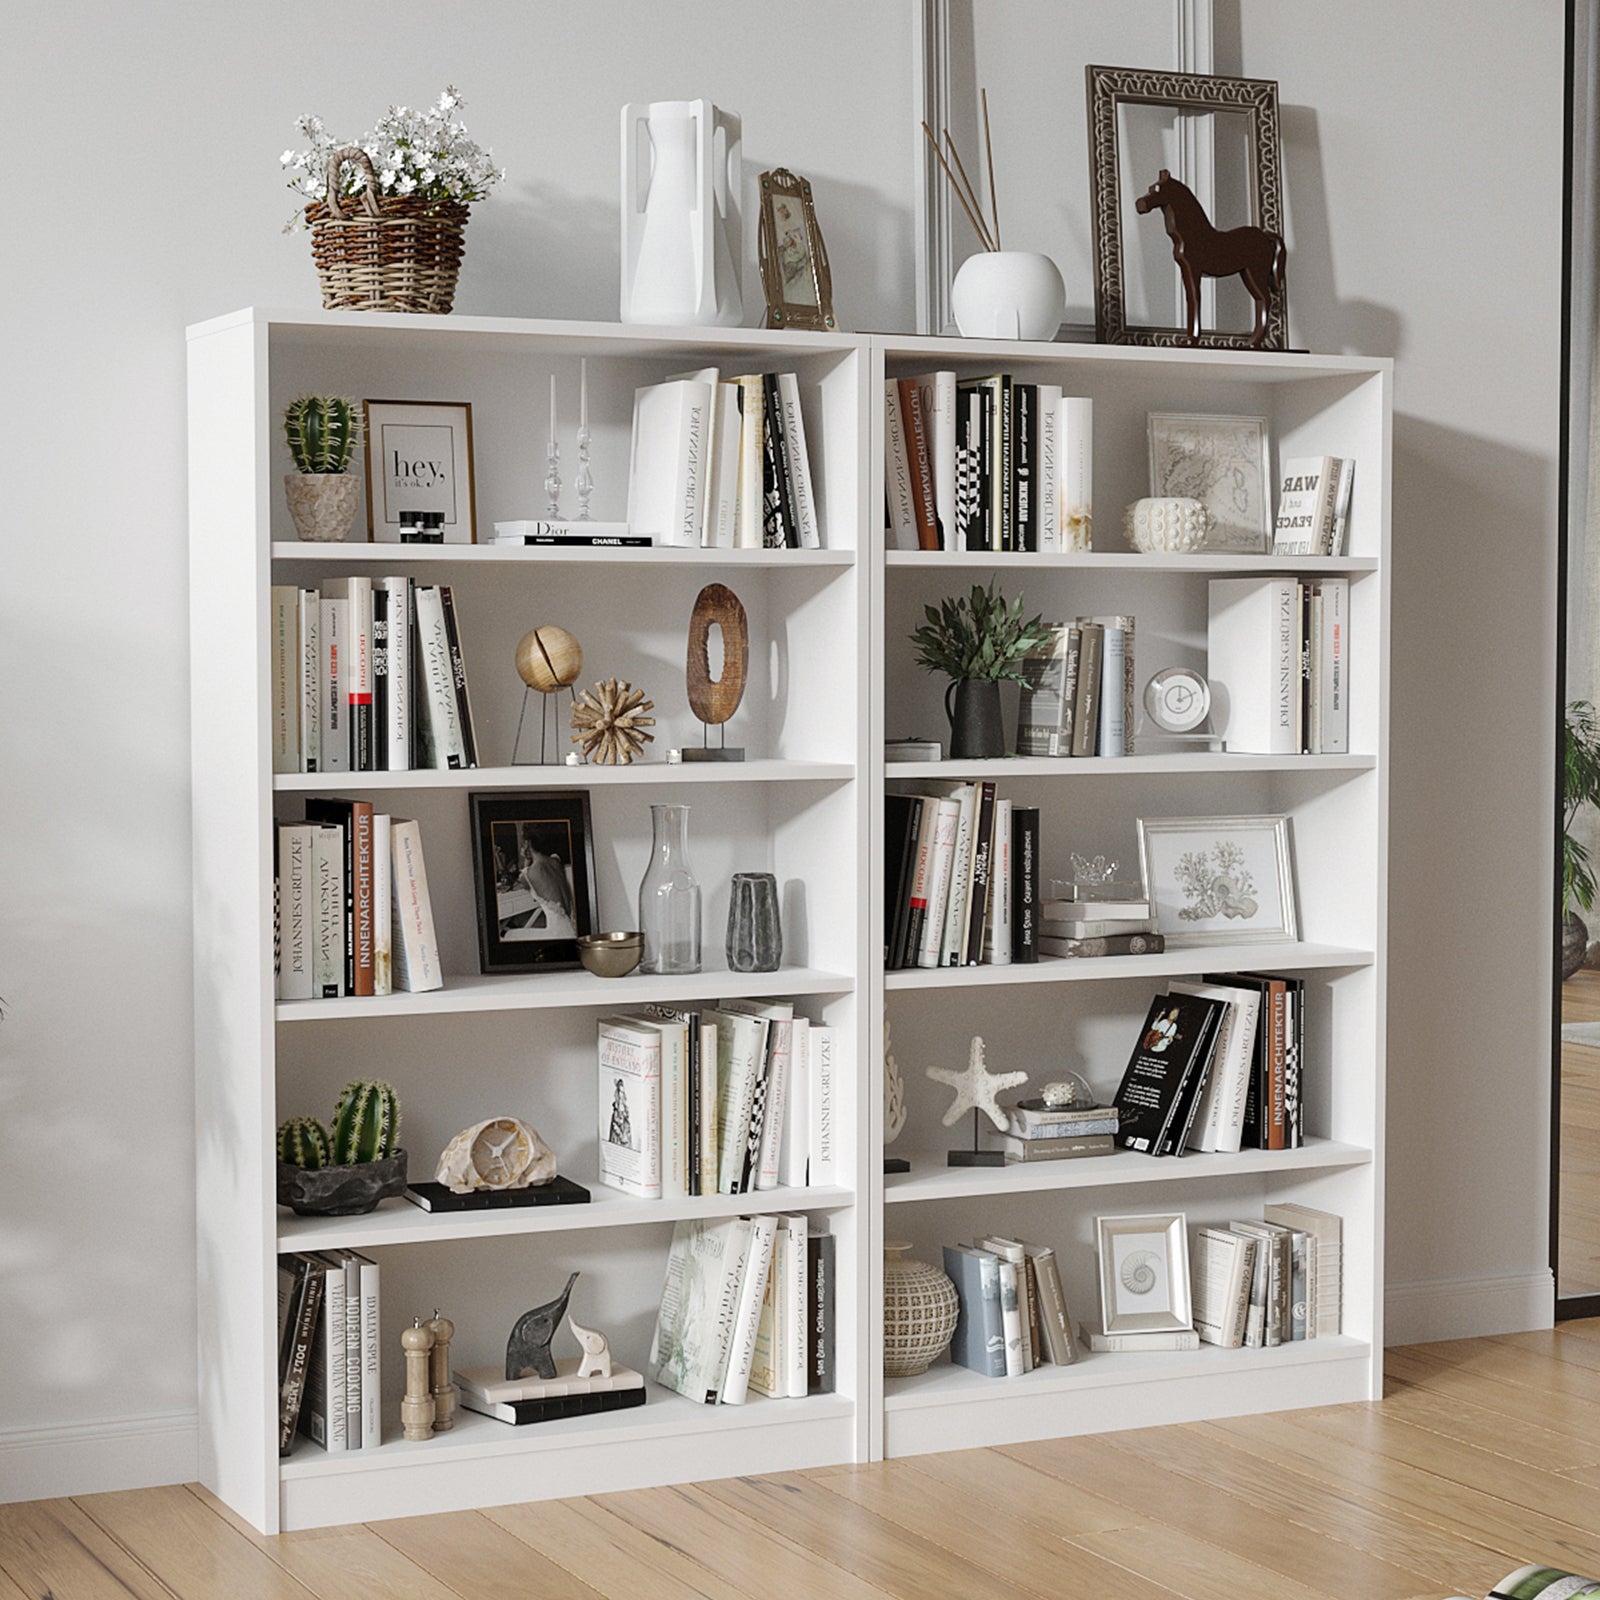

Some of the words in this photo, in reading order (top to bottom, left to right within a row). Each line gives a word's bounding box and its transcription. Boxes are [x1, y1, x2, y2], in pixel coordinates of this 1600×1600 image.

[394, 450, 445, 488] hey,
[536, 522, 570, 536] Dior
[591, 537, 623, 546] CHANEL
[1065, 678, 1076, 701] Holmes
[1067, 649, 1078, 677] Sherlock
[1279, 655, 1290, 728] JOHANNES
[358, 814, 370, 968] INNENARCHITEKTUR
[292, 903, 304, 974] JOHANNES
[1274, 992, 1283, 1126] INNENARCHITEKTUR
[1230, 1061, 1247, 1127] JOHANNES
[820, 1102, 831, 1162] JOHANNES
[331, 1284, 345, 1347] VEGETARIAN
[346, 1296, 360, 1350] MODERN
[332, 1353, 345, 1388] INDIAN
[347, 1357, 361, 1413] COOKING
[332, 1395, 345, 1442] COOKING
